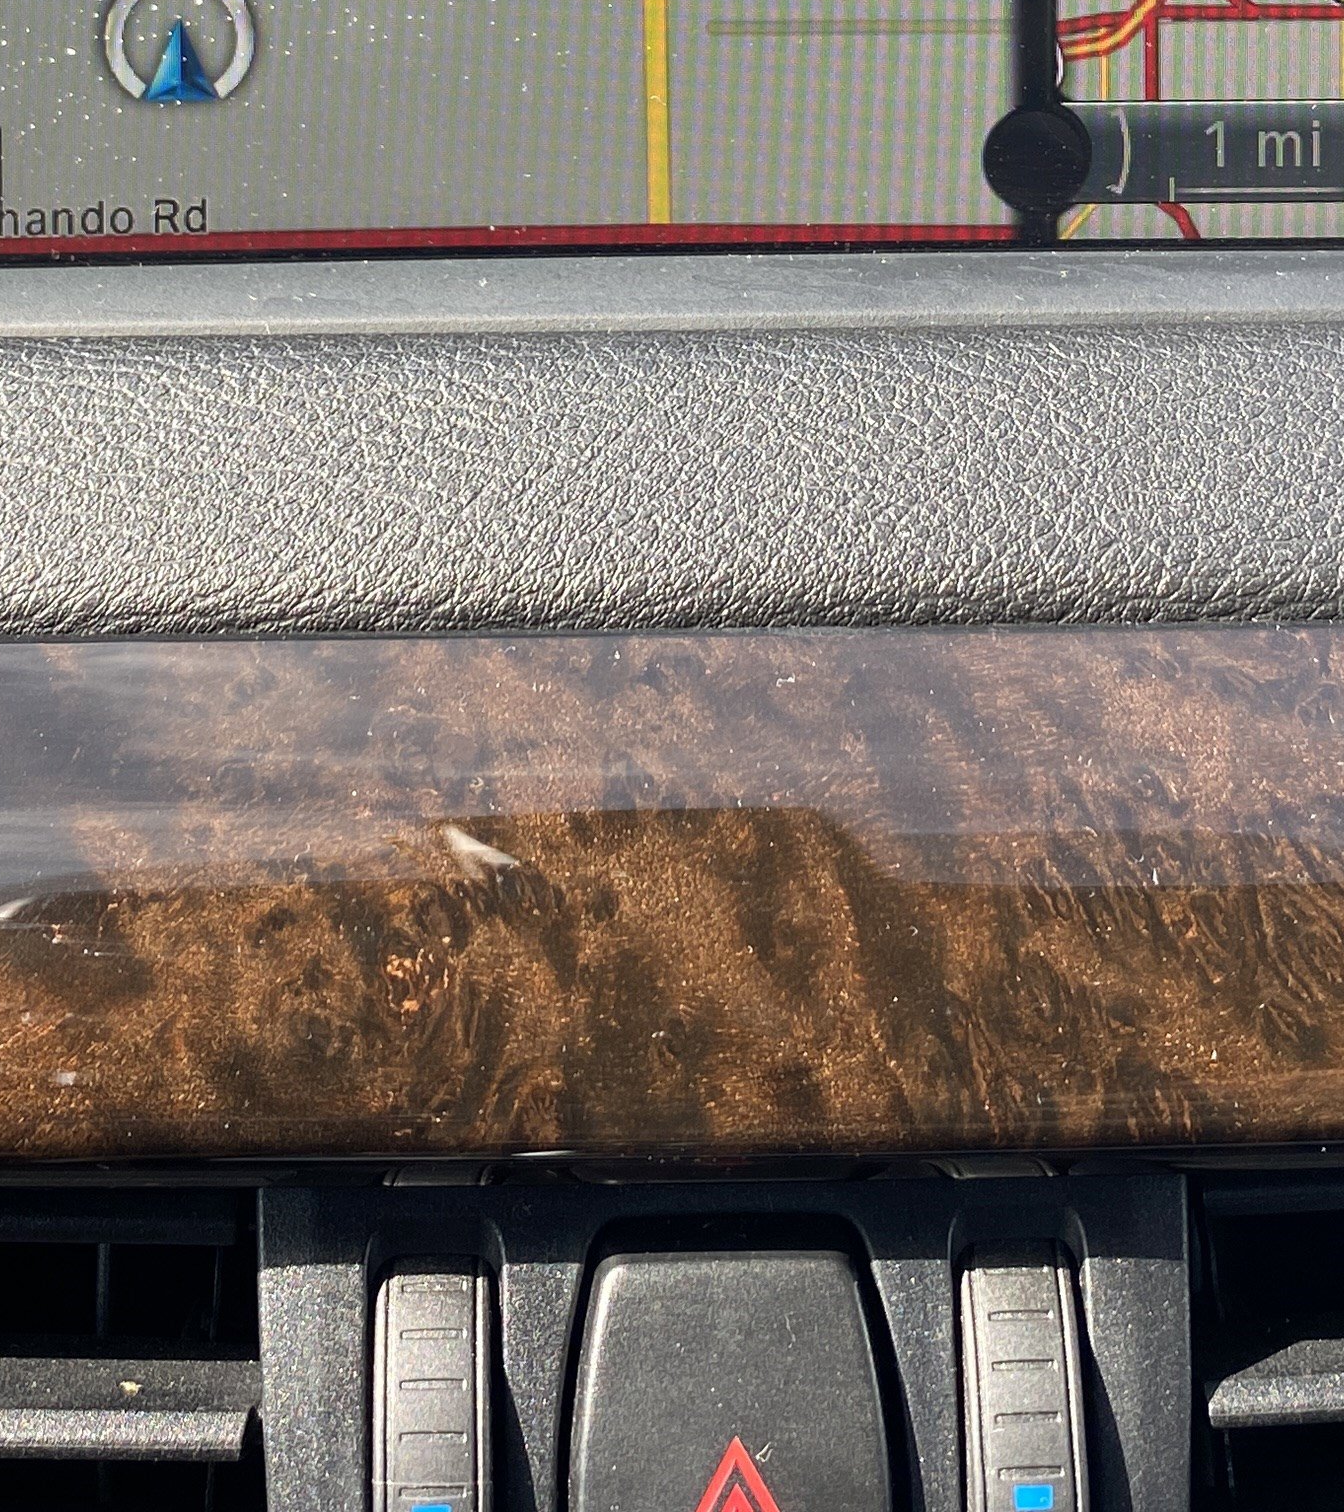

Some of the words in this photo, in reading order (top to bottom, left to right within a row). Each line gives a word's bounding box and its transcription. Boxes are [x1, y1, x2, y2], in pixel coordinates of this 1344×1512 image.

[1205, 120, 1227, 168] 1
[1256, 120, 1322, 168] mi
[154, 198, 208, 234] Rd
